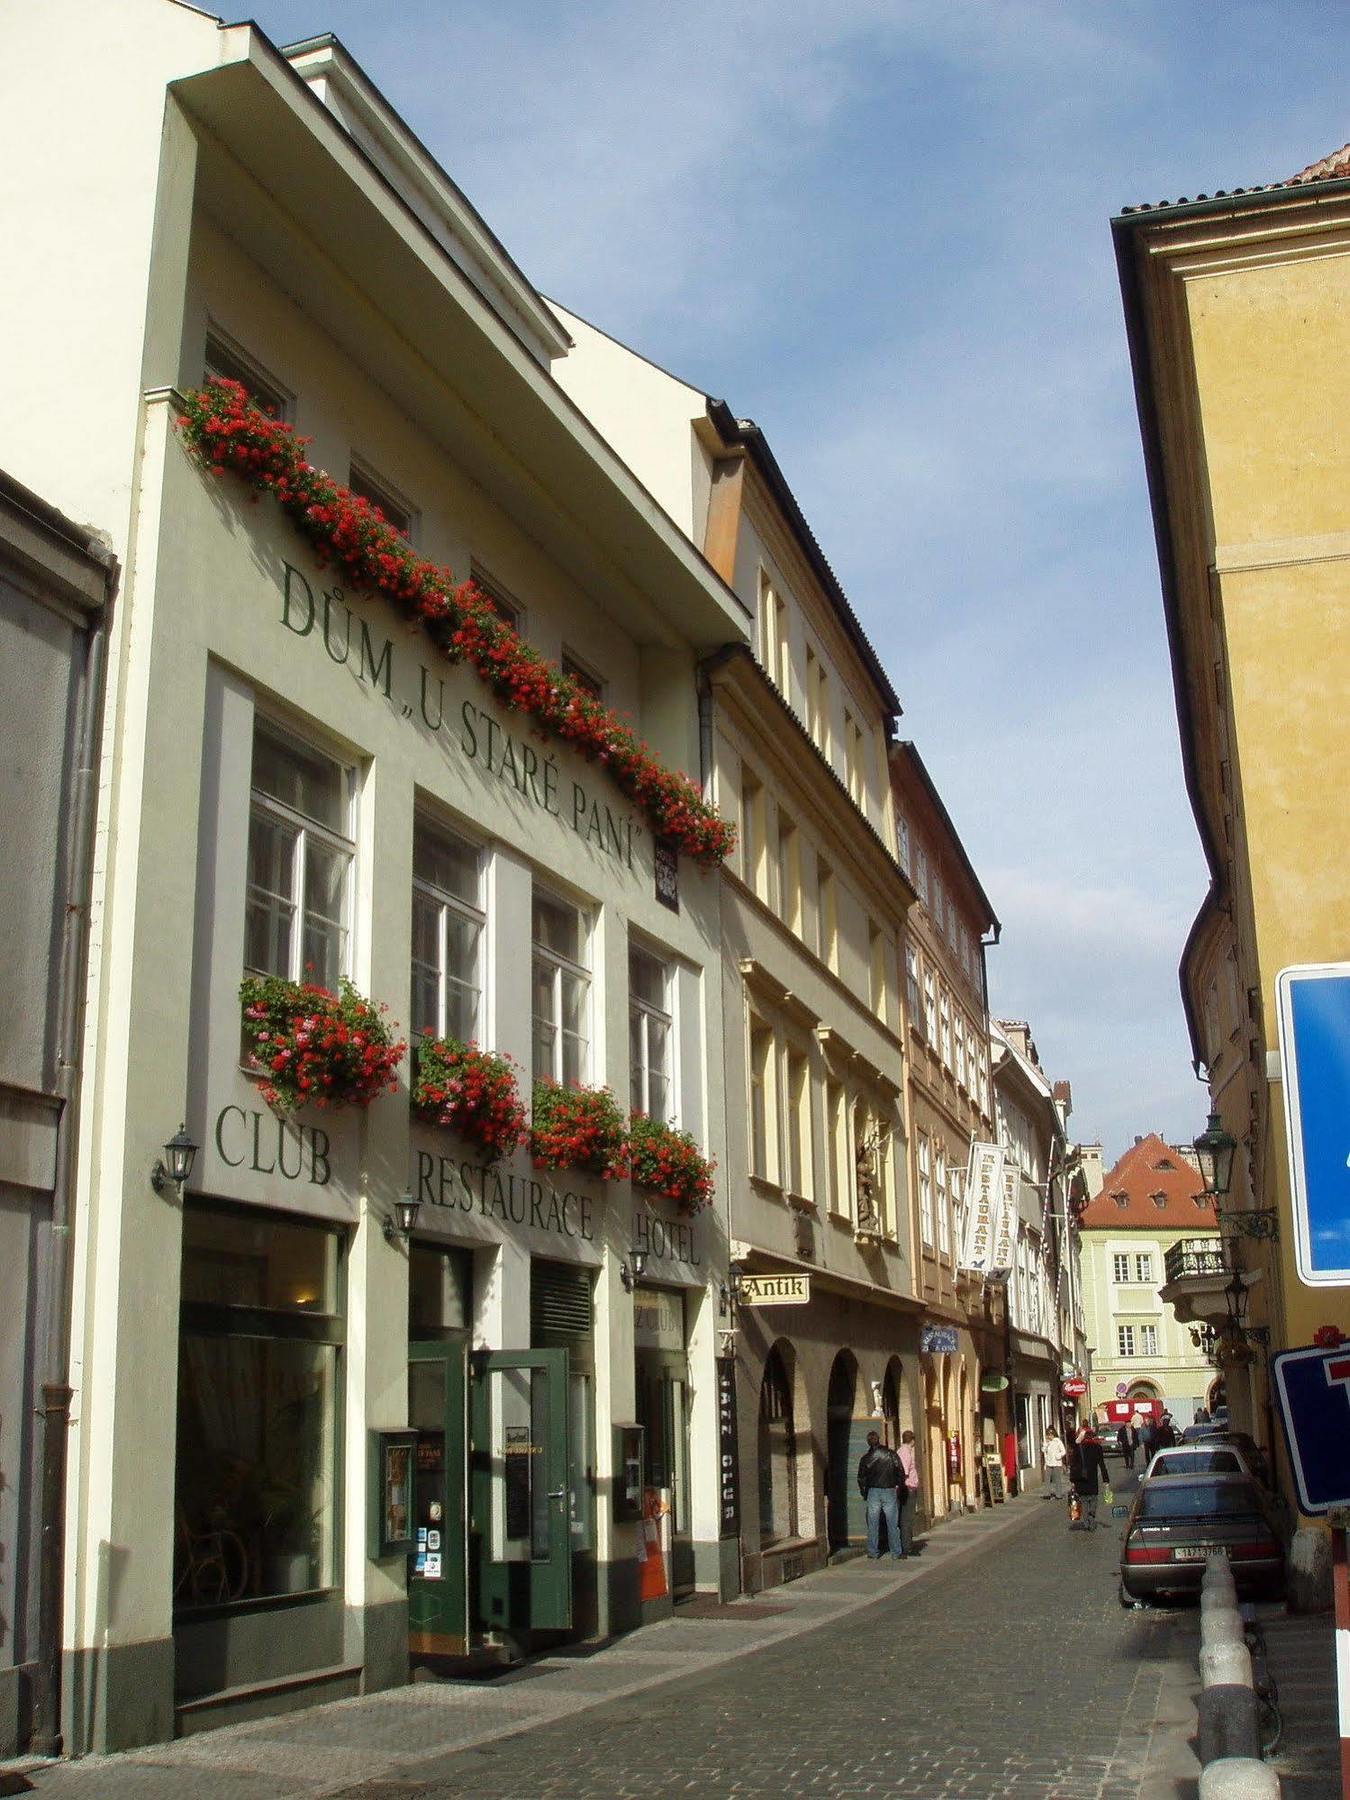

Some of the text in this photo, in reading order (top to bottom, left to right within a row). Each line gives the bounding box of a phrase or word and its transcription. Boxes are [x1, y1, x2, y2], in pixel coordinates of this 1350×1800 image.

[279, 558, 394, 702] DŮM
[461, 700, 560, 818] STARÉ
[215, 1104, 331, 1186] CLUB
[417, 1151, 595, 1241] RESTAURACE
[974, 1154, 996, 1255] RESTAURANT
[636, 1212, 700, 1266] HOTEL
[742, 1277, 804, 1298] Antik
[721, 1454, 735, 1519] CLUB
